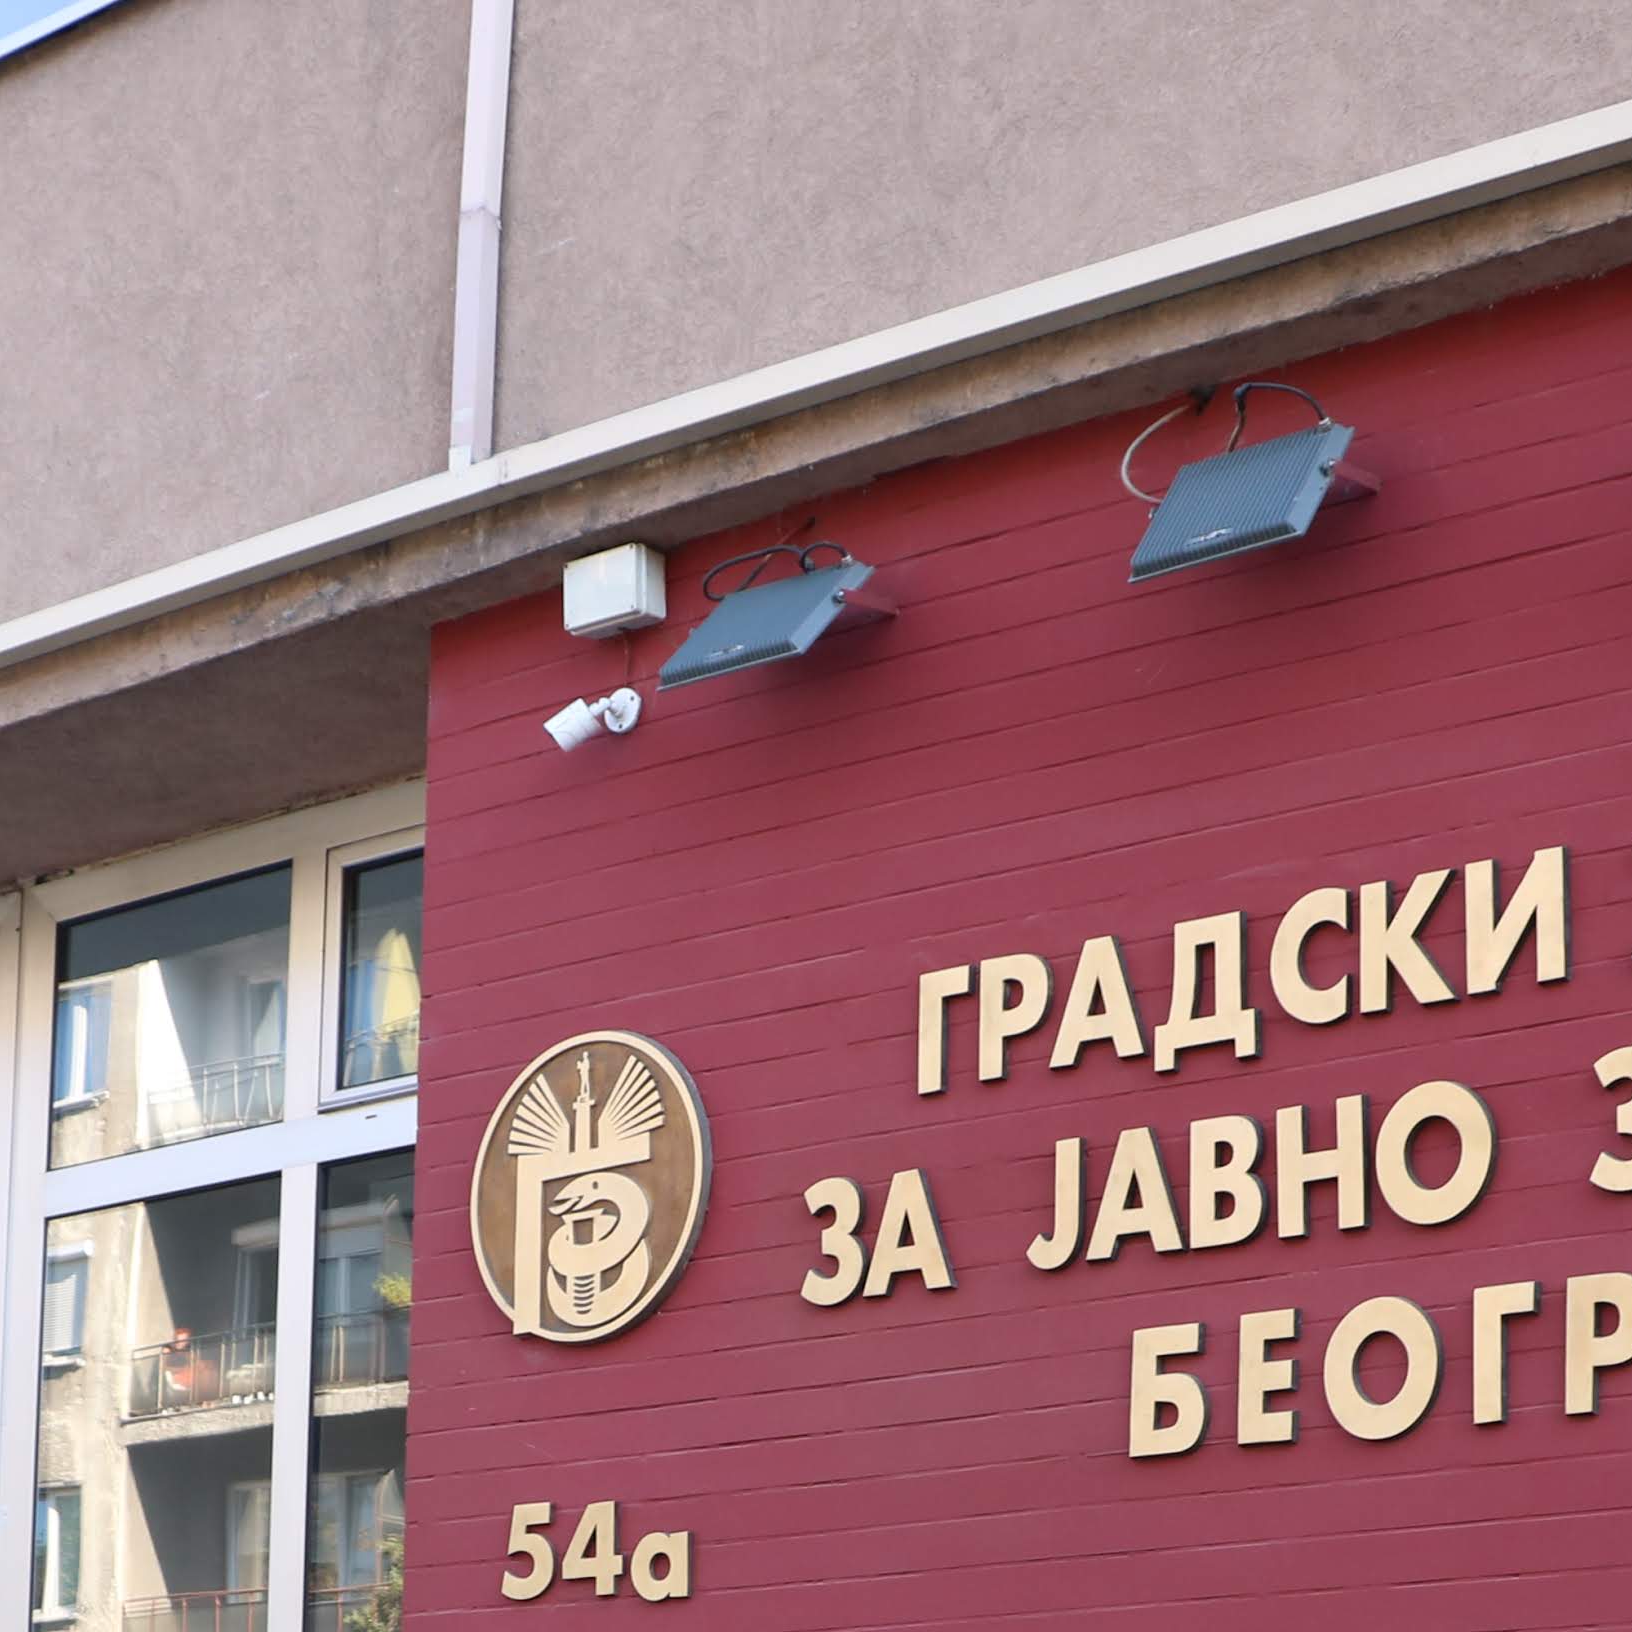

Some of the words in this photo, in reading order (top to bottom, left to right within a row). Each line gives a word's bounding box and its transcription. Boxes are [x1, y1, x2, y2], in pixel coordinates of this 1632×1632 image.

[918, 847, 1567, 1095] ГРАДСКИ
[801, 1169, 954, 1306] ЗА
[1026, 1081, 1494, 1270] ЈАВНО
